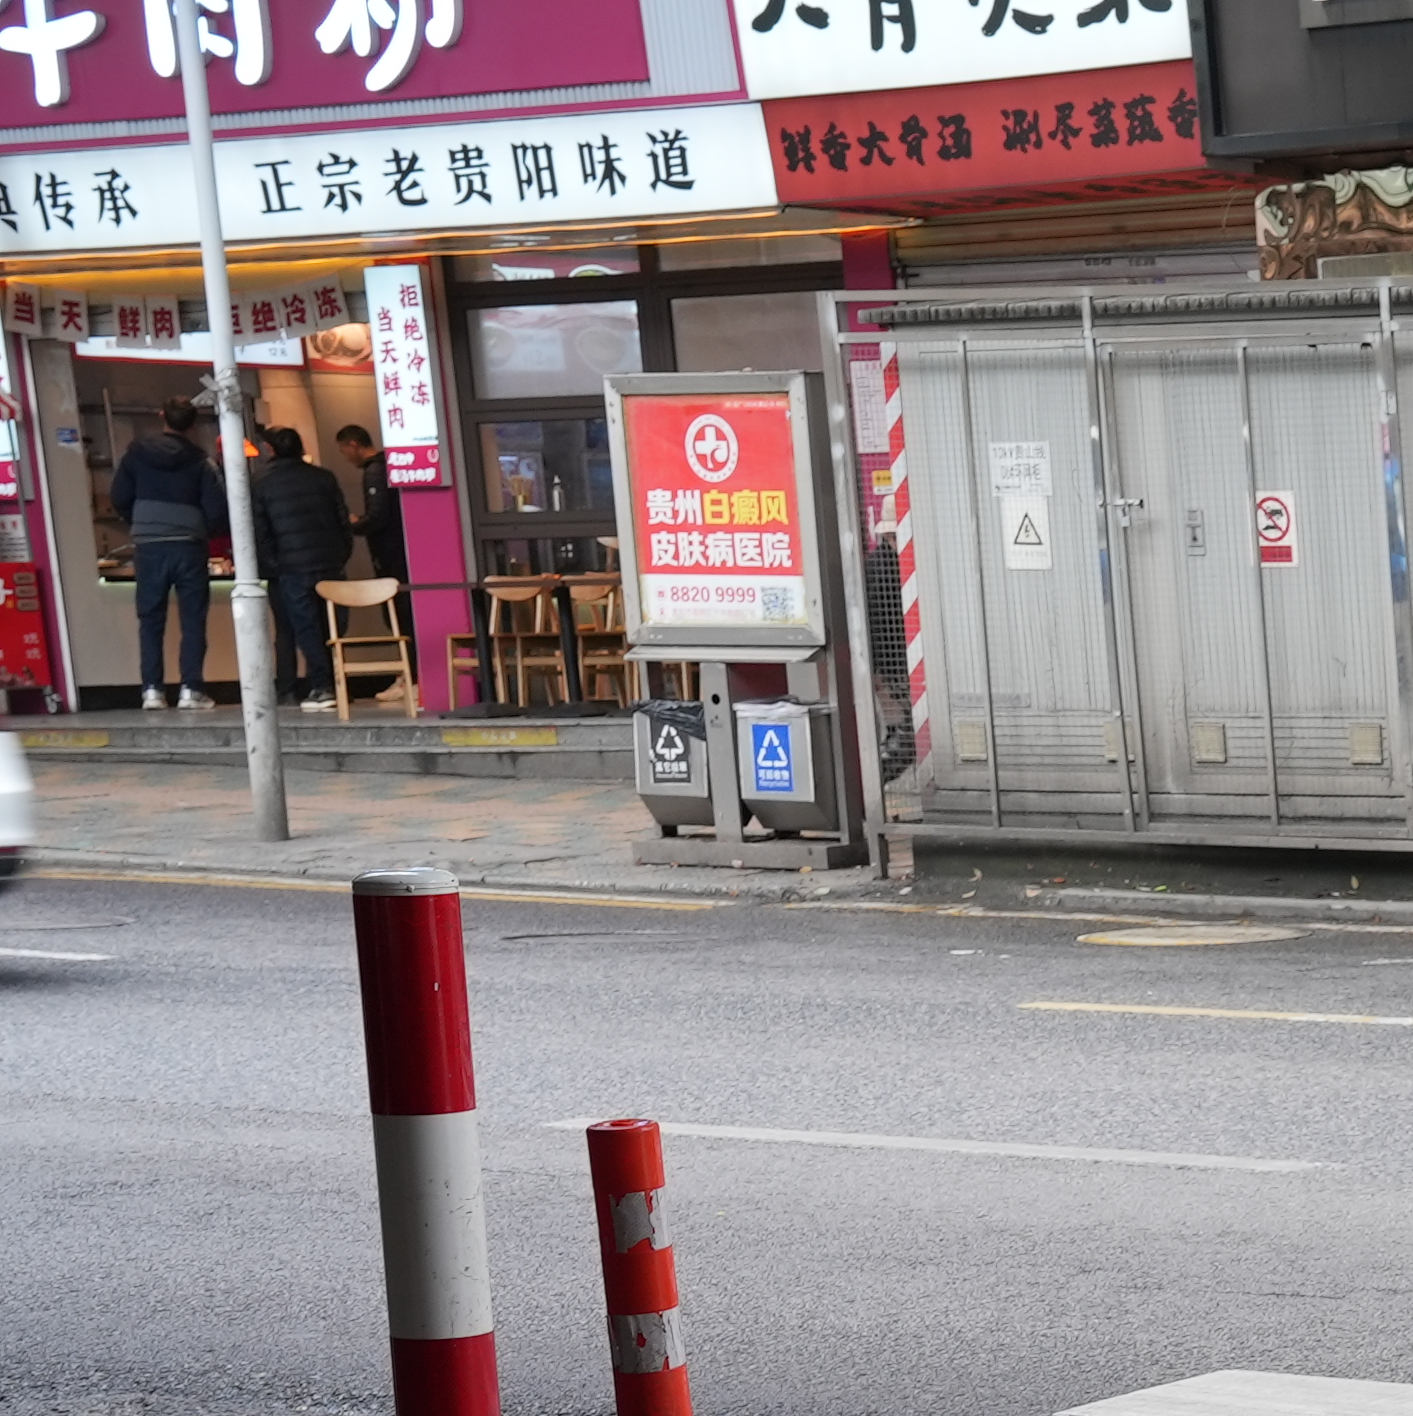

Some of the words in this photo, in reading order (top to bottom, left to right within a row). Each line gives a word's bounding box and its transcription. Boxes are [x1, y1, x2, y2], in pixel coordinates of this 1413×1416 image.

[253, 128, 697, 215] 正宗老贵阳味道
[13, 291, 177, 340] 当天鲜肉
[376, 306, 406, 430] 当天鲜肉
[398, 283, 431, 407] 拒绝冷冻
[645, 488, 790, 525] 贵州白癜风
[649, 530, 793, 568] 皮肤病医院
[670, 586, 710, 603] 8820
[715, 586, 756, 604] 9999
